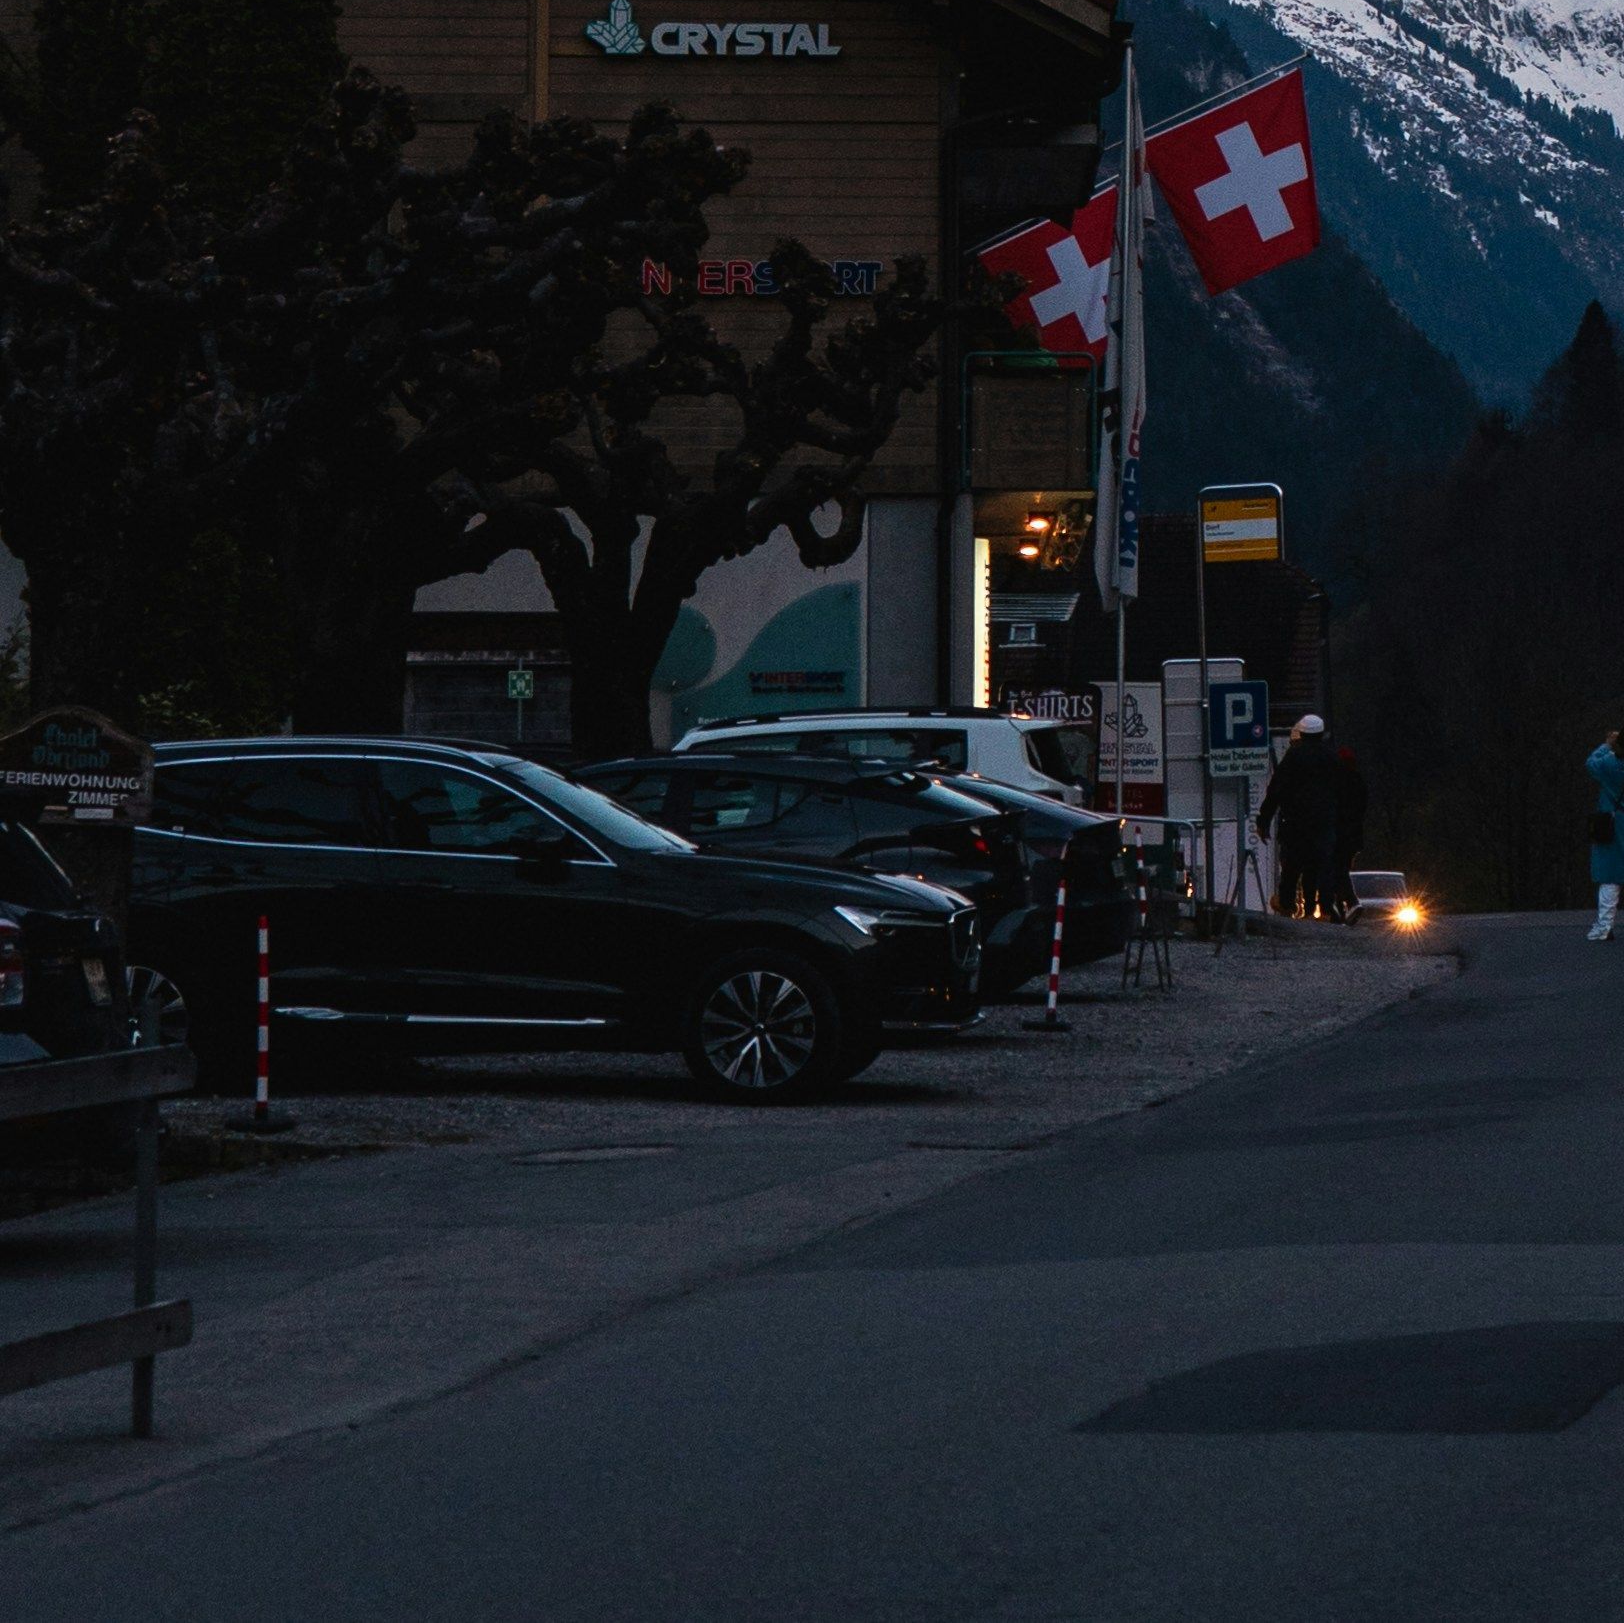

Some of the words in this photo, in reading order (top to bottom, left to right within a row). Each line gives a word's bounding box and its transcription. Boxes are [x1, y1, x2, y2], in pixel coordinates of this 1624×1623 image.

[651, 22, 842, 56] CRYSTAL
[1006, 695, 1094, 719] T-SHIRTS
[1225, 692, 1253, 740] P
